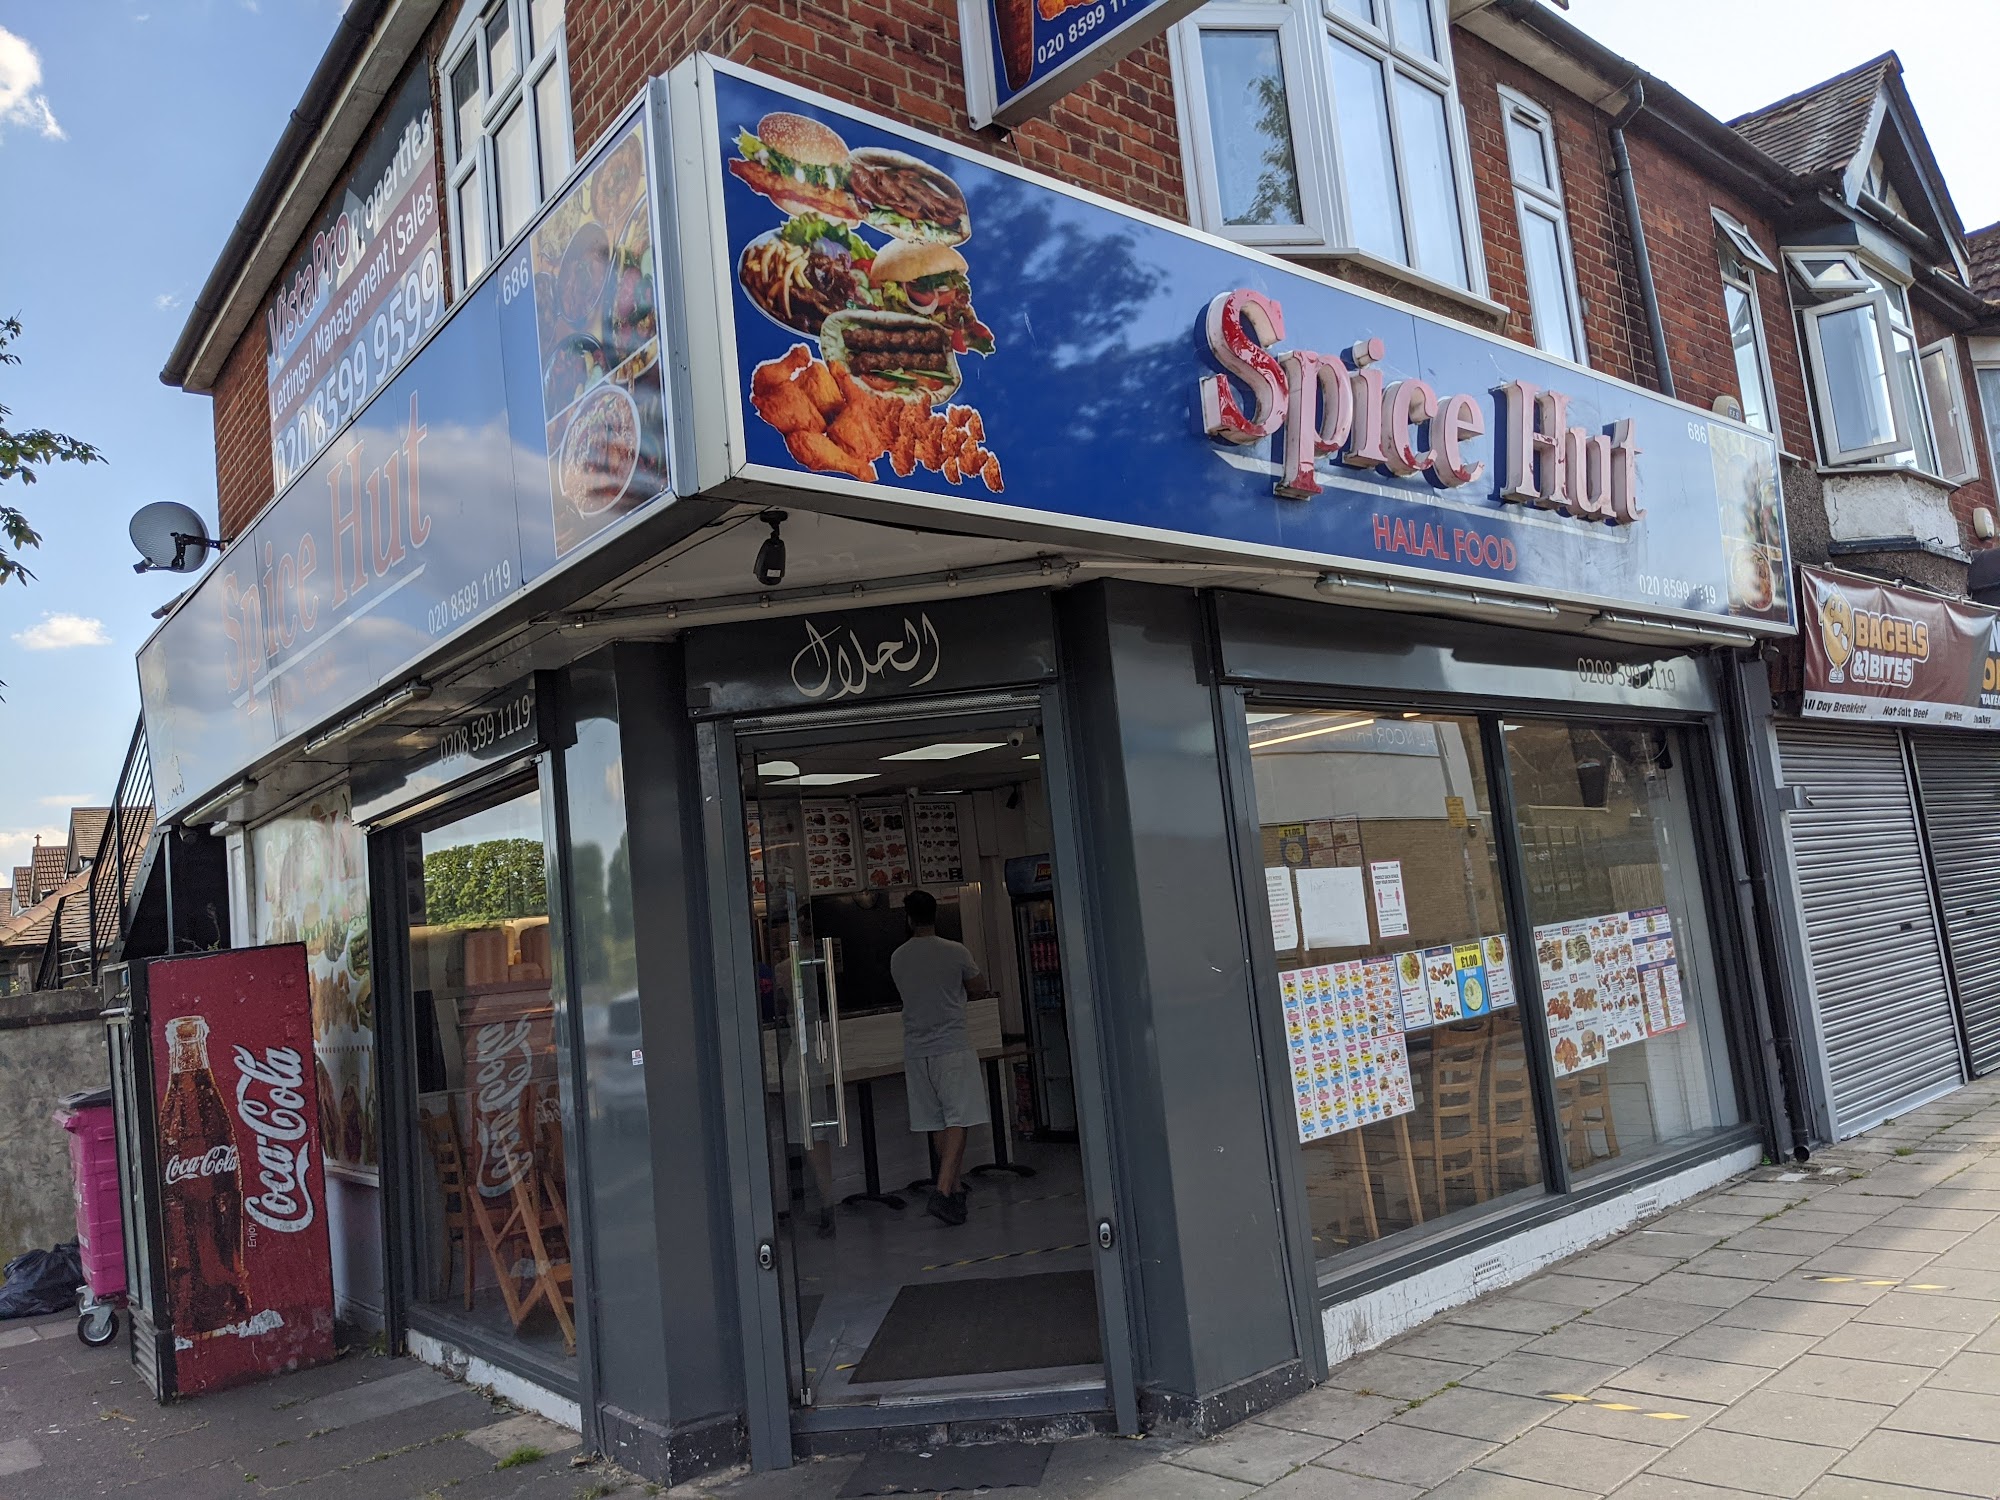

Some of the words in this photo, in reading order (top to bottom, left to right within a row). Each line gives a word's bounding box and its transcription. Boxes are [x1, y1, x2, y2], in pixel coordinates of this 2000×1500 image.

[1037, 33, 1064, 64] 020
[1068, 4, 1105, 43] 8599
[351, 108, 432, 255] Properties
[272, 358, 310, 422] Lettings
[315, 237, 391, 364] Management
[397, 182, 433, 255] Sales
[502, 257, 529, 305] 686
[274, 411, 309, 491] 020
[313, 340, 367, 450] 8599
[373, 247, 439, 386] 9599
[1200, 288, 1485, 500] Spice
[1499, 379, 1647, 526] Hut
[1687, 421, 1707, 445] 686
[221, 532, 320, 716] Spice
[327, 390, 432, 612] Hut
[1372, 512, 1450, 562] HALAL
[1454, 528, 1517, 572] FOOD
[428, 600, 448, 635] 020
[451, 581, 479, 621] 8599
[482, 559, 511, 600] 1119
[1639, 574, 1660, 596] 020
[1663, 577, 1690, 601] 8599
[1693, 583, 1716, 605] 119
[1854, 611, 1928, 658] BAGELS
[1577, 657, 1614, 685] 0208
[1616, 662, 1642, 689] 599
[1645, 667, 1676, 691] 1119
[1853, 651, 1868, 680] &
[1870, 654, 1912, 684] BITES
[440, 727, 469, 766] 0208
[470, 711, 495, 751] 599
[498, 693, 531, 739] 1119
[1816, 700, 1833, 713] Day
[1833, 702, 1867, 714] Breakfast
[1882, 706, 1897, 716] Hot
[1913, 708, 1929, 719] Beef
[1461, 954, 1478, 968] £1.00
[247, 1222, 257, 1248] Enjoy
